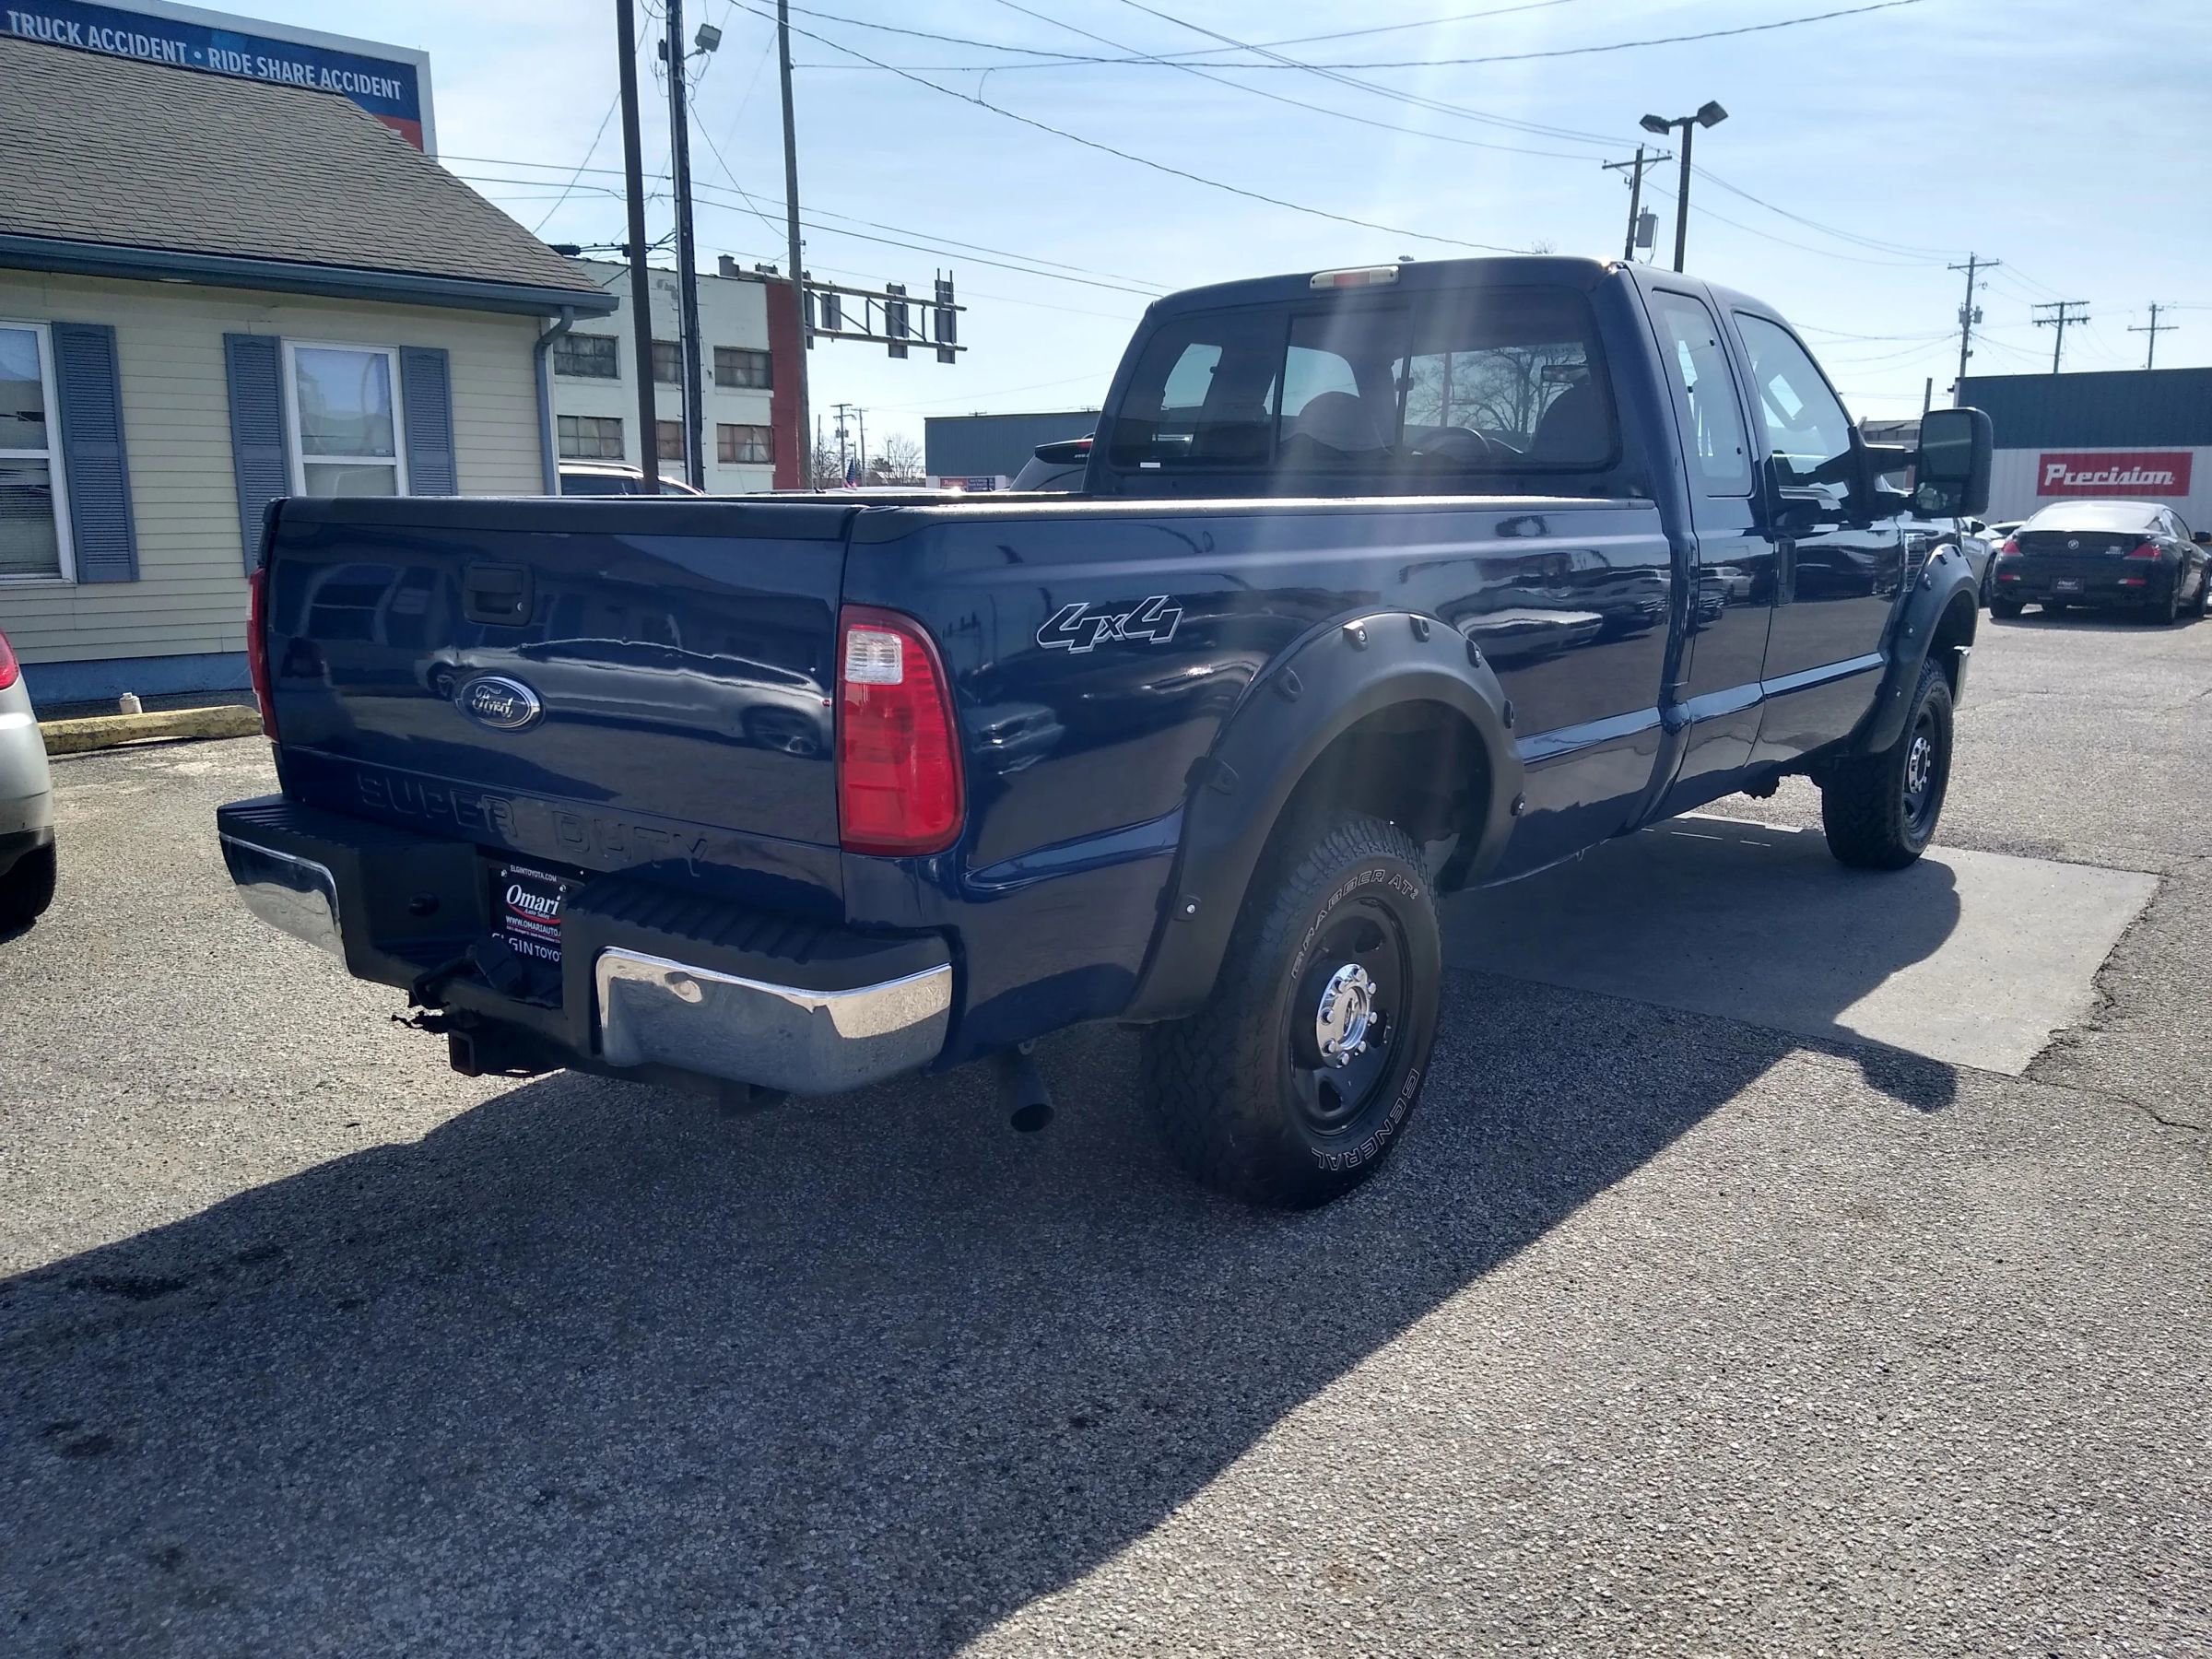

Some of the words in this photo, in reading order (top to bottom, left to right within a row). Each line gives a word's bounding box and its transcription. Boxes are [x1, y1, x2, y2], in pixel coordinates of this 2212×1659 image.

[6, 10, 84, 46] TRUCK
[88, 25, 187, 65] ACCIDENT
[207, 47, 253, 76] RIDE
[257, 56, 316, 87] SHARE
[320, 67, 402, 100] ACCIDENT
[2043, 463, 2175, 486] Precision
[1036, 594, 1183, 654] 4x4
[357, 773, 519, 838] SUPER
[551, 810, 709, 877] DUTY
[510, 865, 558, 882] ELGINTOYOTA.COM
[506, 884, 561, 915] Omari
[505, 915, 561, 936] WWW.OMARIAUTO.
[1290, 869, 1386, 979] GRABBER
[535, 945, 562, 962] TOYO
[1311, 1068, 1420, 1171] GENERAL
